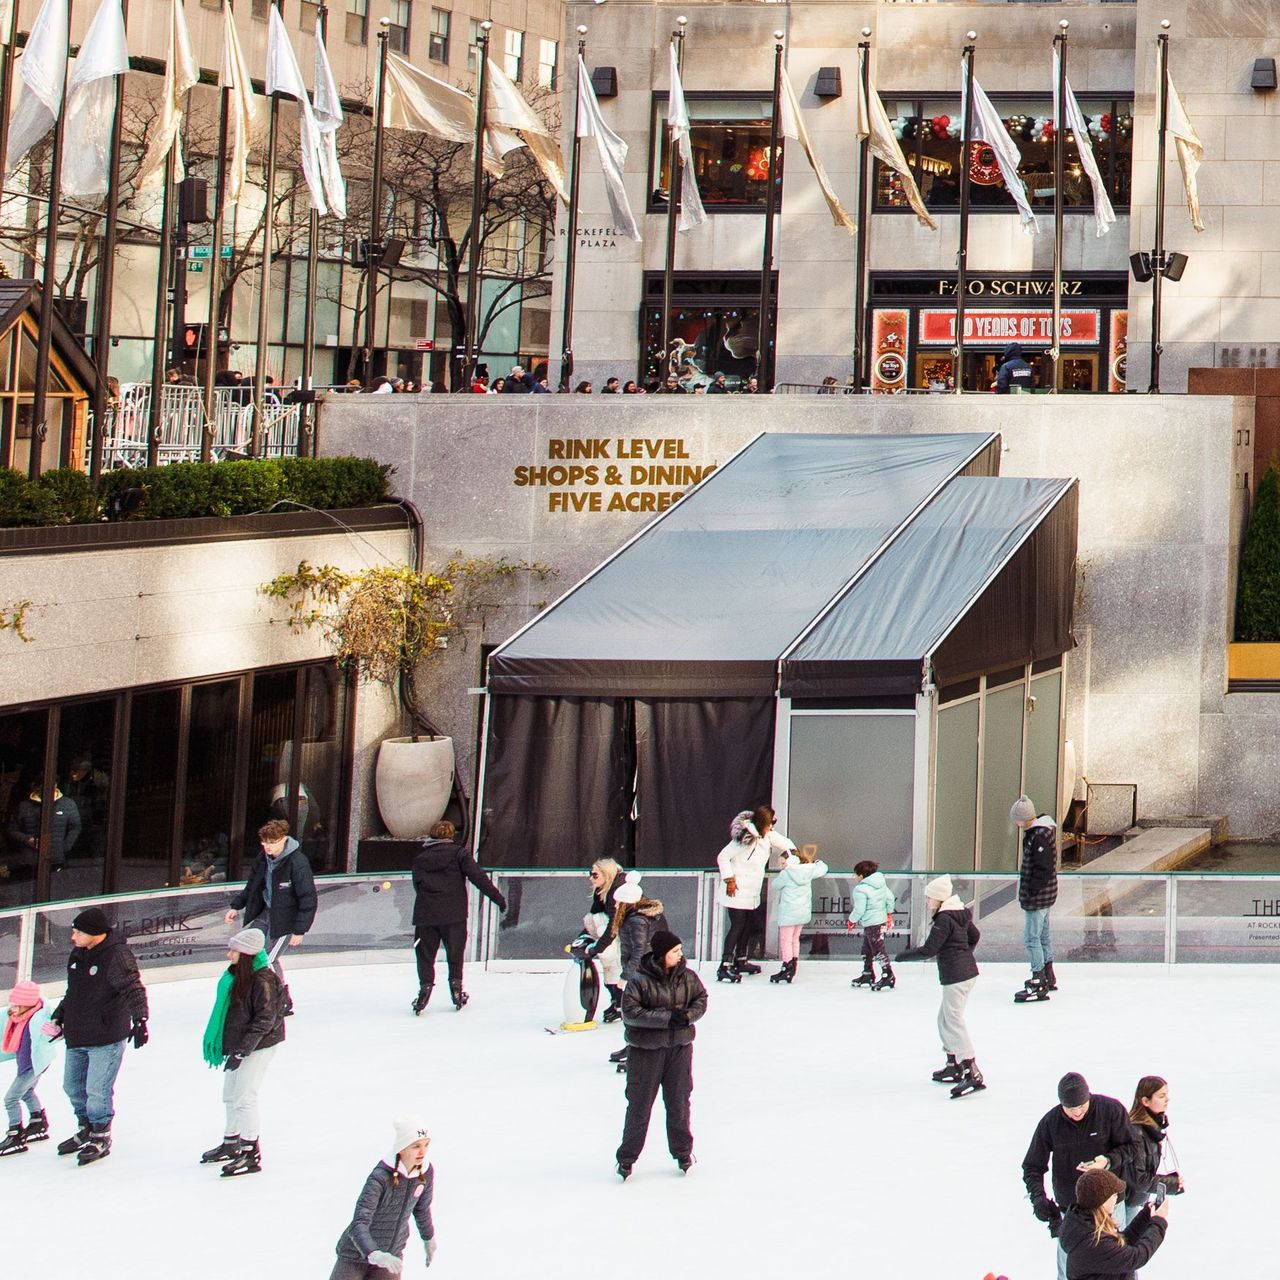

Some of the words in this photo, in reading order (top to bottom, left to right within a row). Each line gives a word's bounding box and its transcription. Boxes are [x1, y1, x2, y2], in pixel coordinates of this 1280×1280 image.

[561, 228, 624, 236] RCKEFEL
[949, 317, 973, 337] 10
[976, 317, 1017, 337] YEARS
[1020, 317, 1037, 337] OF
[549, 439, 610, 459] RINK
[617, 439, 689, 459] LEVEL
[514, 465, 599, 486] SHOPS
[604, 465, 623, 486] &
[549, 492, 602, 512] FIVE
[820, 896, 850, 913] THE
[141, 913, 191, 933] RINK
